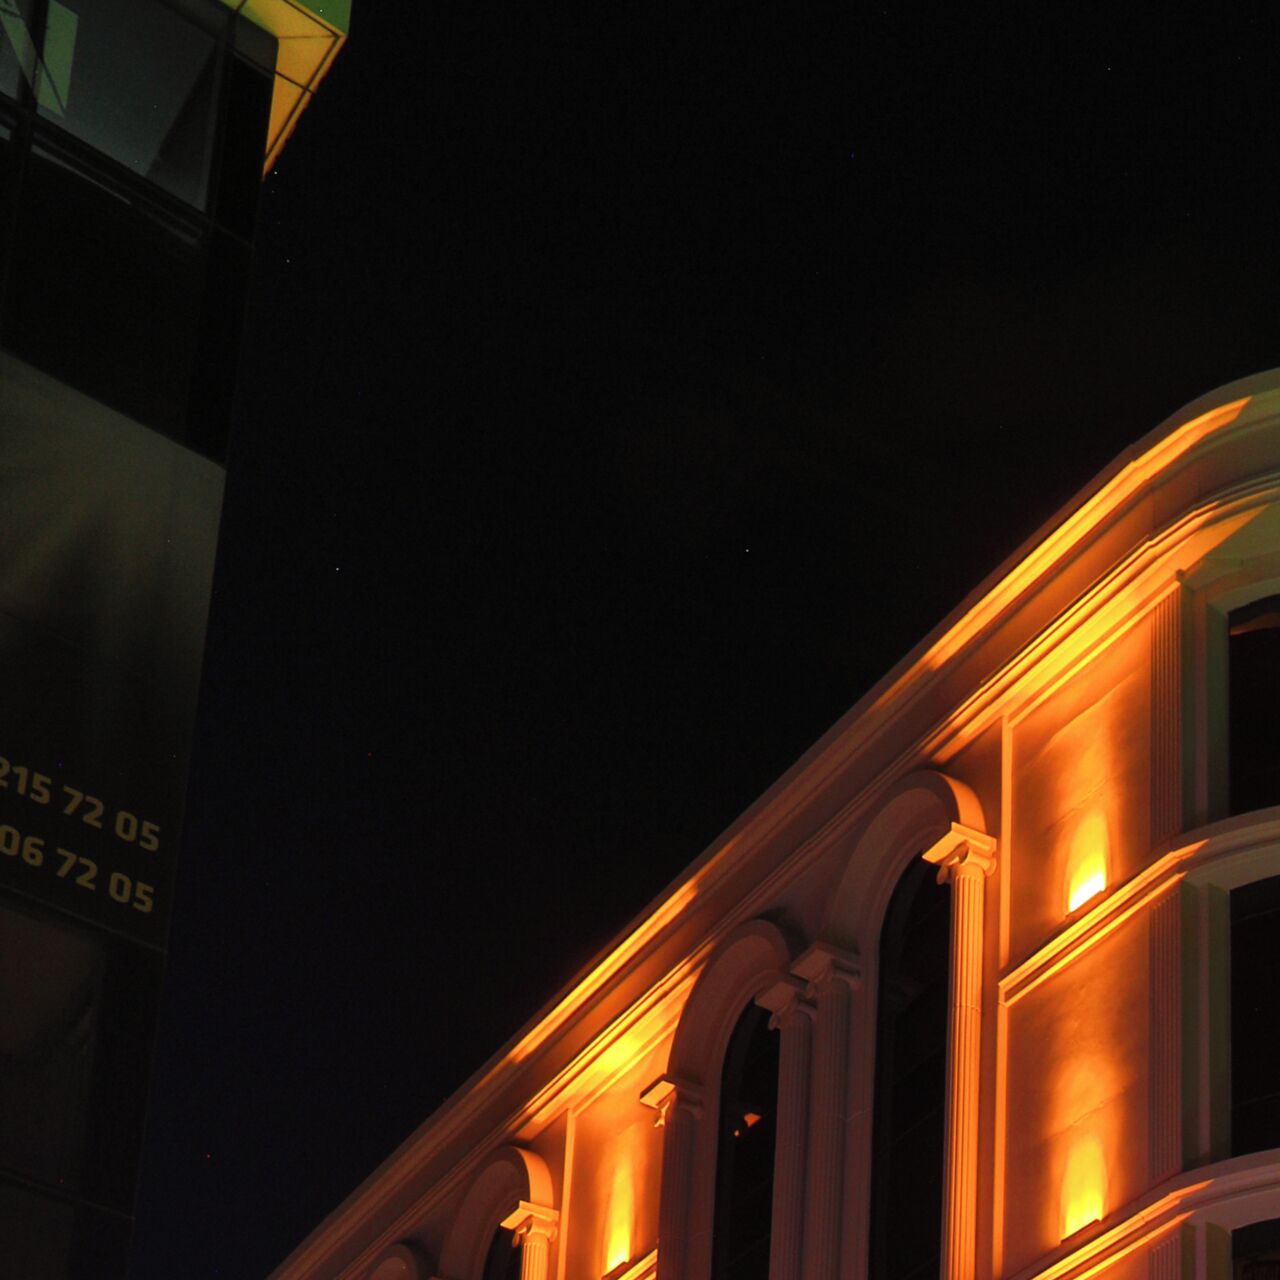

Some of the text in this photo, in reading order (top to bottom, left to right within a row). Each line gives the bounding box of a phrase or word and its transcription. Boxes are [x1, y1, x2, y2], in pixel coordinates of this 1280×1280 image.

[63, 785, 105, 829] 72
[114, 810, 161, 853] 05
[56, 847, 98, 891] 72
[108, 872, 154, 913] 05
